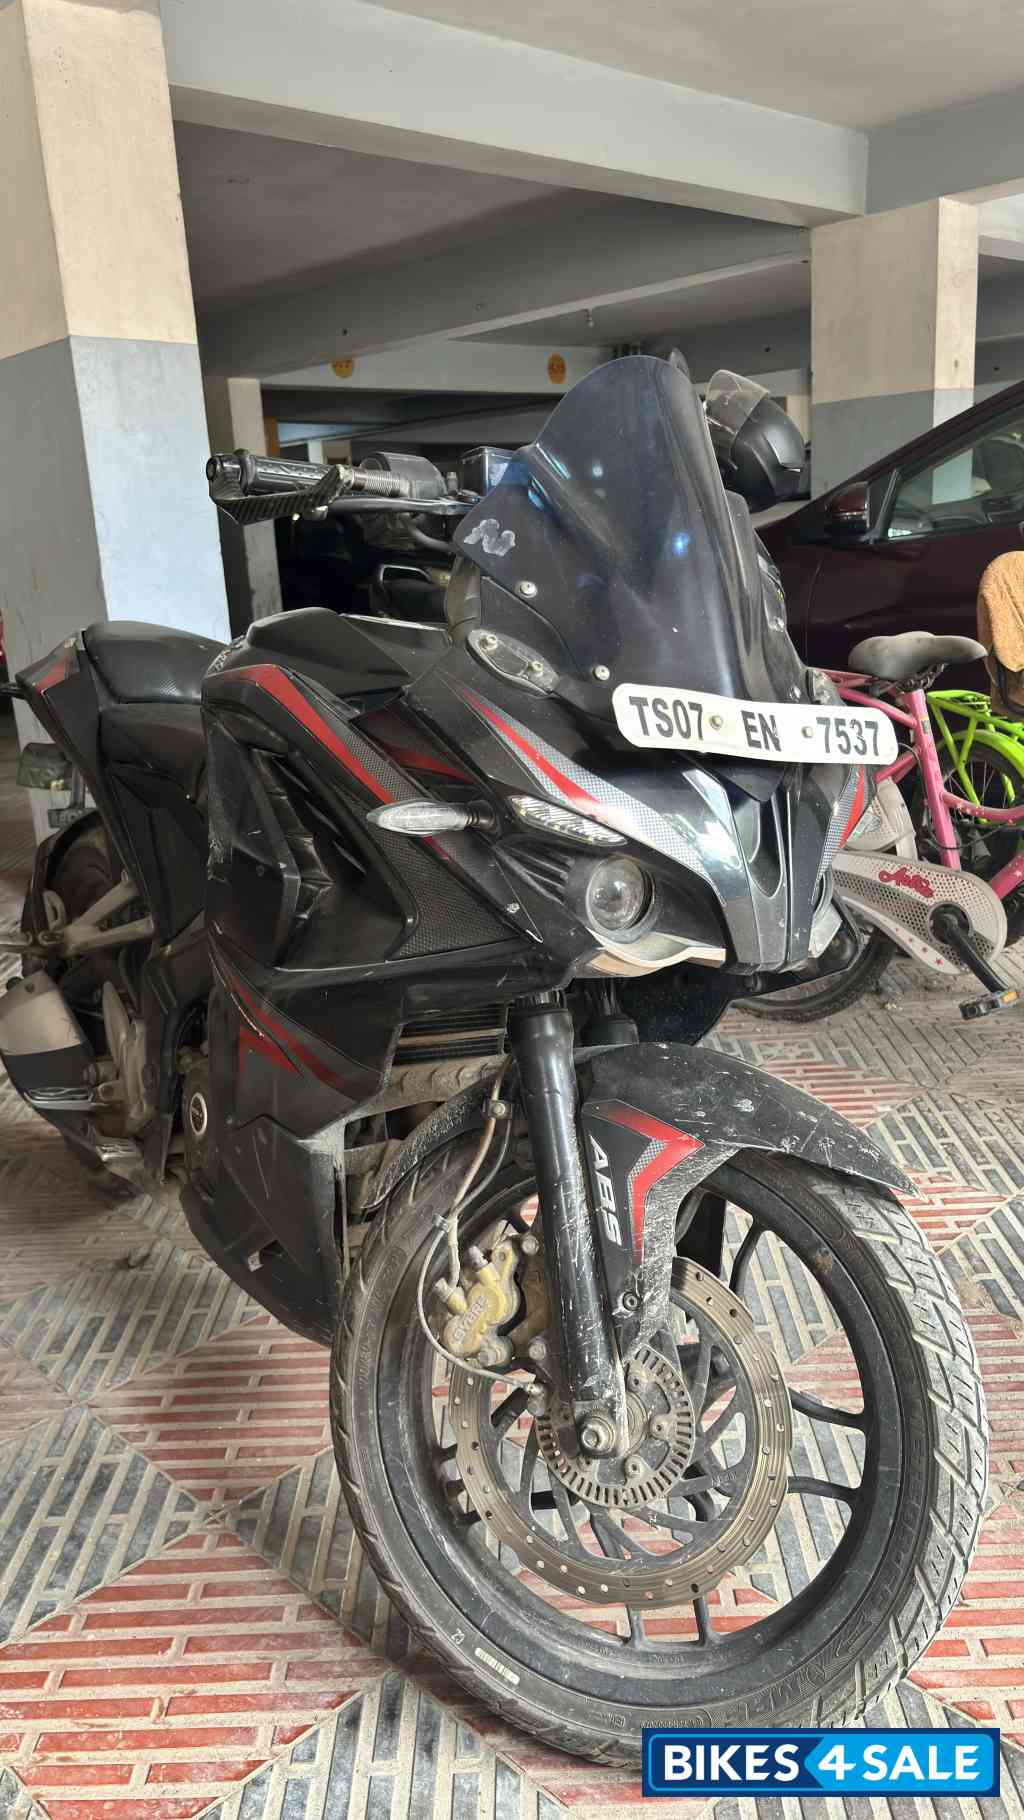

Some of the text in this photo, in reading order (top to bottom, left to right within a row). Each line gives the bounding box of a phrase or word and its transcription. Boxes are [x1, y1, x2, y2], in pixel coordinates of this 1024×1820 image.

[629, 695, 880, 756] TS07 EN 7537
[590, 1134, 622, 1247] ABS
